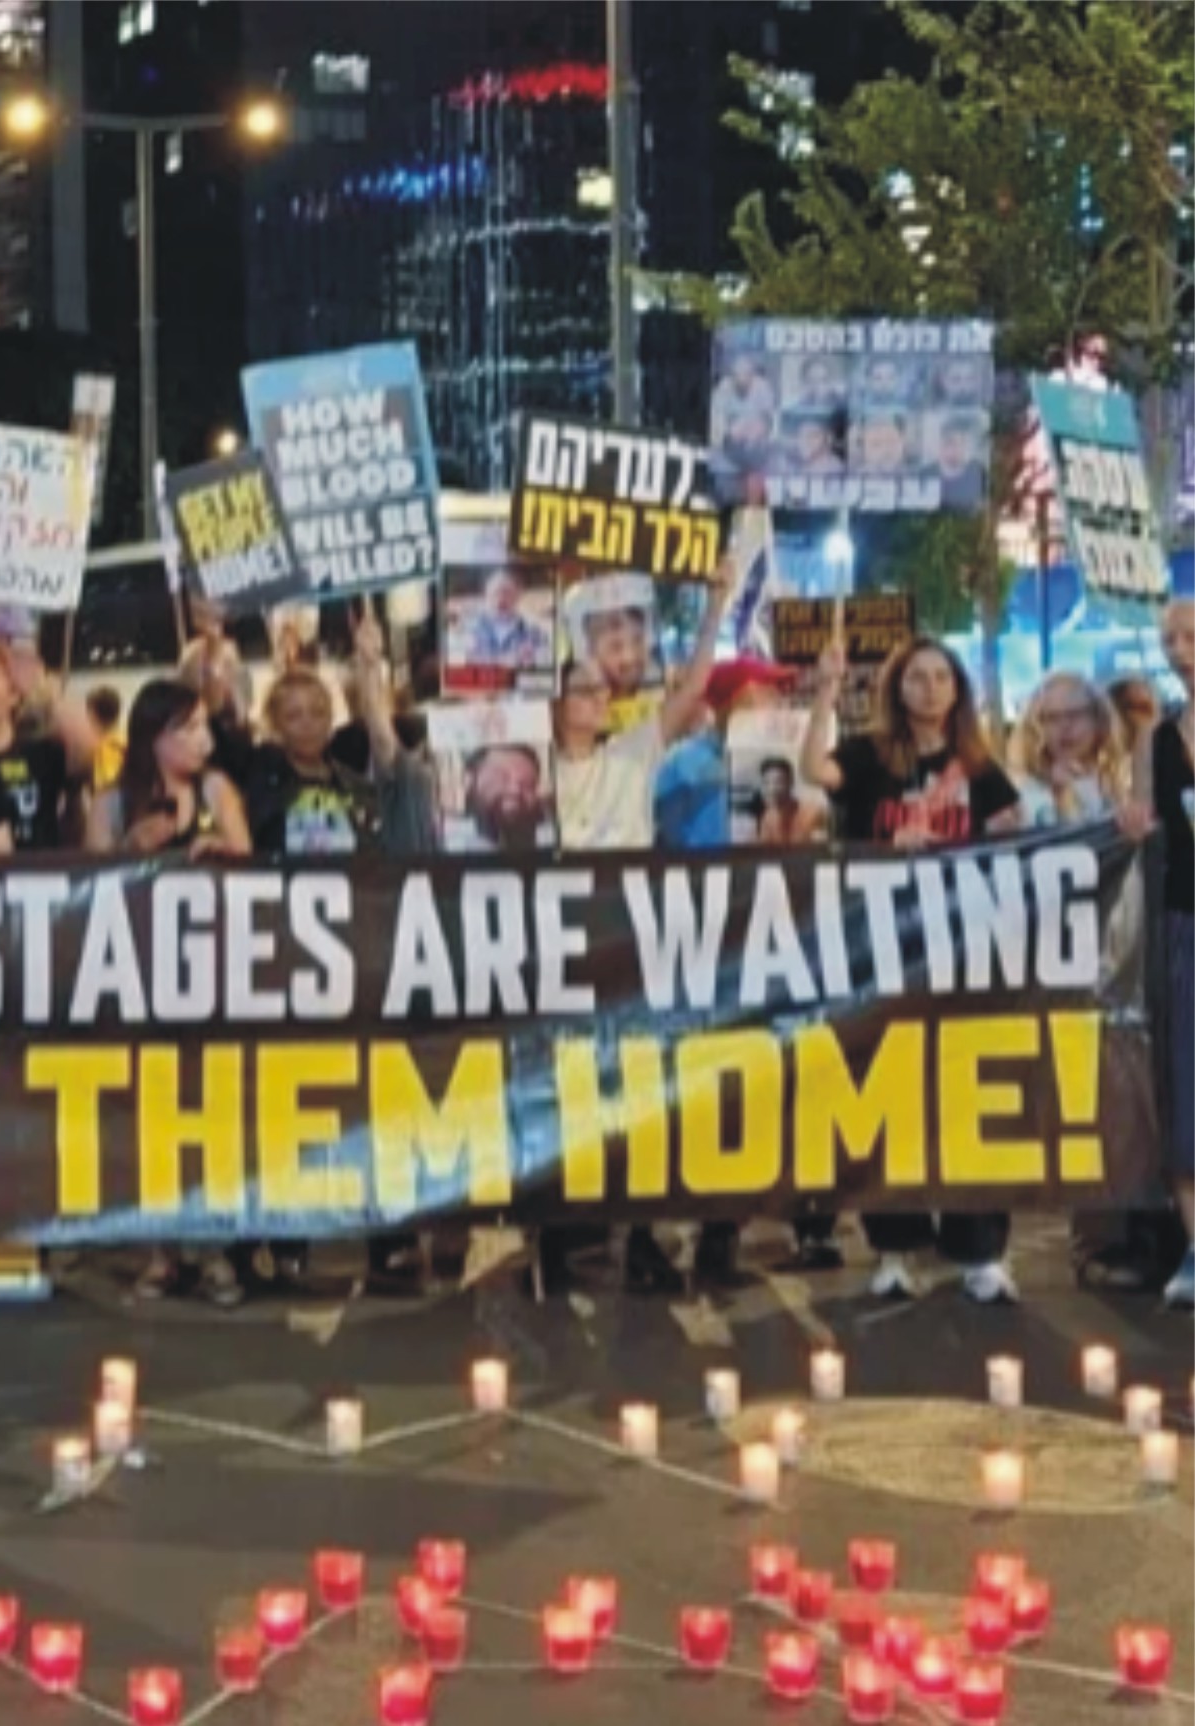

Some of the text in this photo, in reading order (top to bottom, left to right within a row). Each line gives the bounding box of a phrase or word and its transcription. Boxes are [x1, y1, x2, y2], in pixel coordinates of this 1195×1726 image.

[279, 387, 385, 437] HOW
[276, 419, 404, 473] MUCH
[279, 459, 417, 513] BLOOD
[518, 487, 720, 577] הלך הבית!
[308, 537, 434, 591] PILLED?
[382, 871, 596, 1018] ARE
[622, 845, 1100, 1011] WAITING
[25, 1041, 513, 1216] THEM
[556, 1011, 1105, 1201] HOME!
